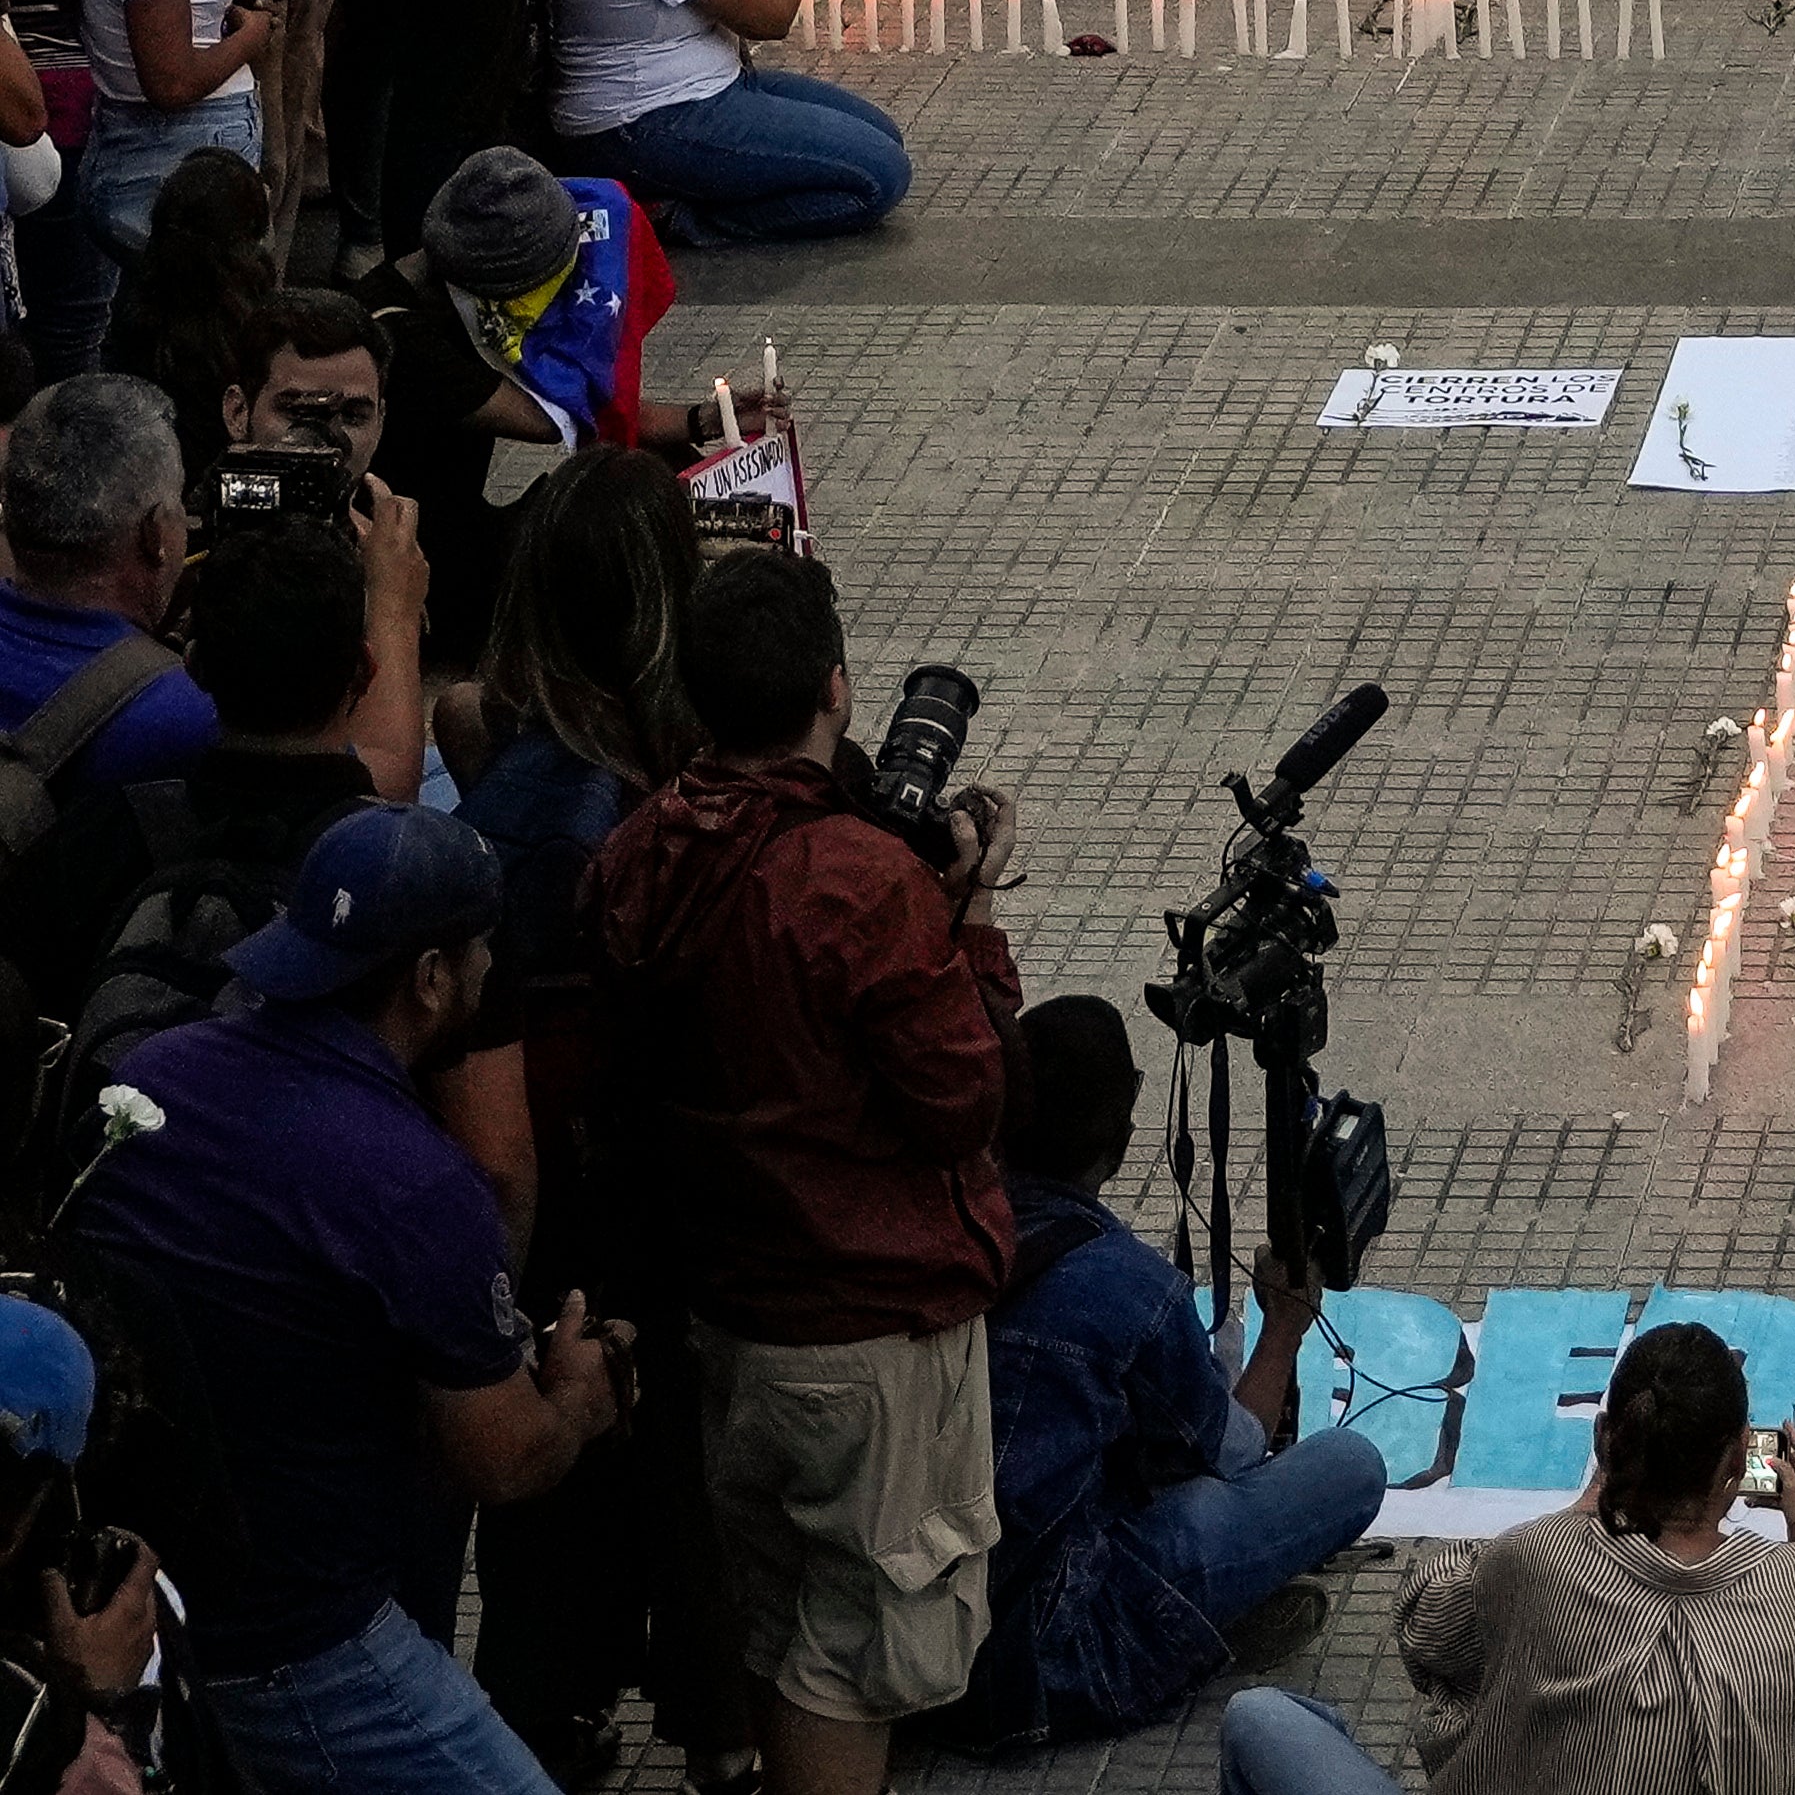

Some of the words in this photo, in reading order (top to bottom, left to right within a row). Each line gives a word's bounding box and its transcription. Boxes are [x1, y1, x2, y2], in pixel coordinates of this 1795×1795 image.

[1381, 375, 1538, 384] CIERREN
[1551, 374, 1617, 383] LOS
[1380, 384, 1548, 394] CENTROS
[1562, 383, 1610, 394] DE
[1403, 395, 1576, 404] TORTURA
[713, 464, 734, 498] UN
[734, 436, 784, 492] ASESINADO
